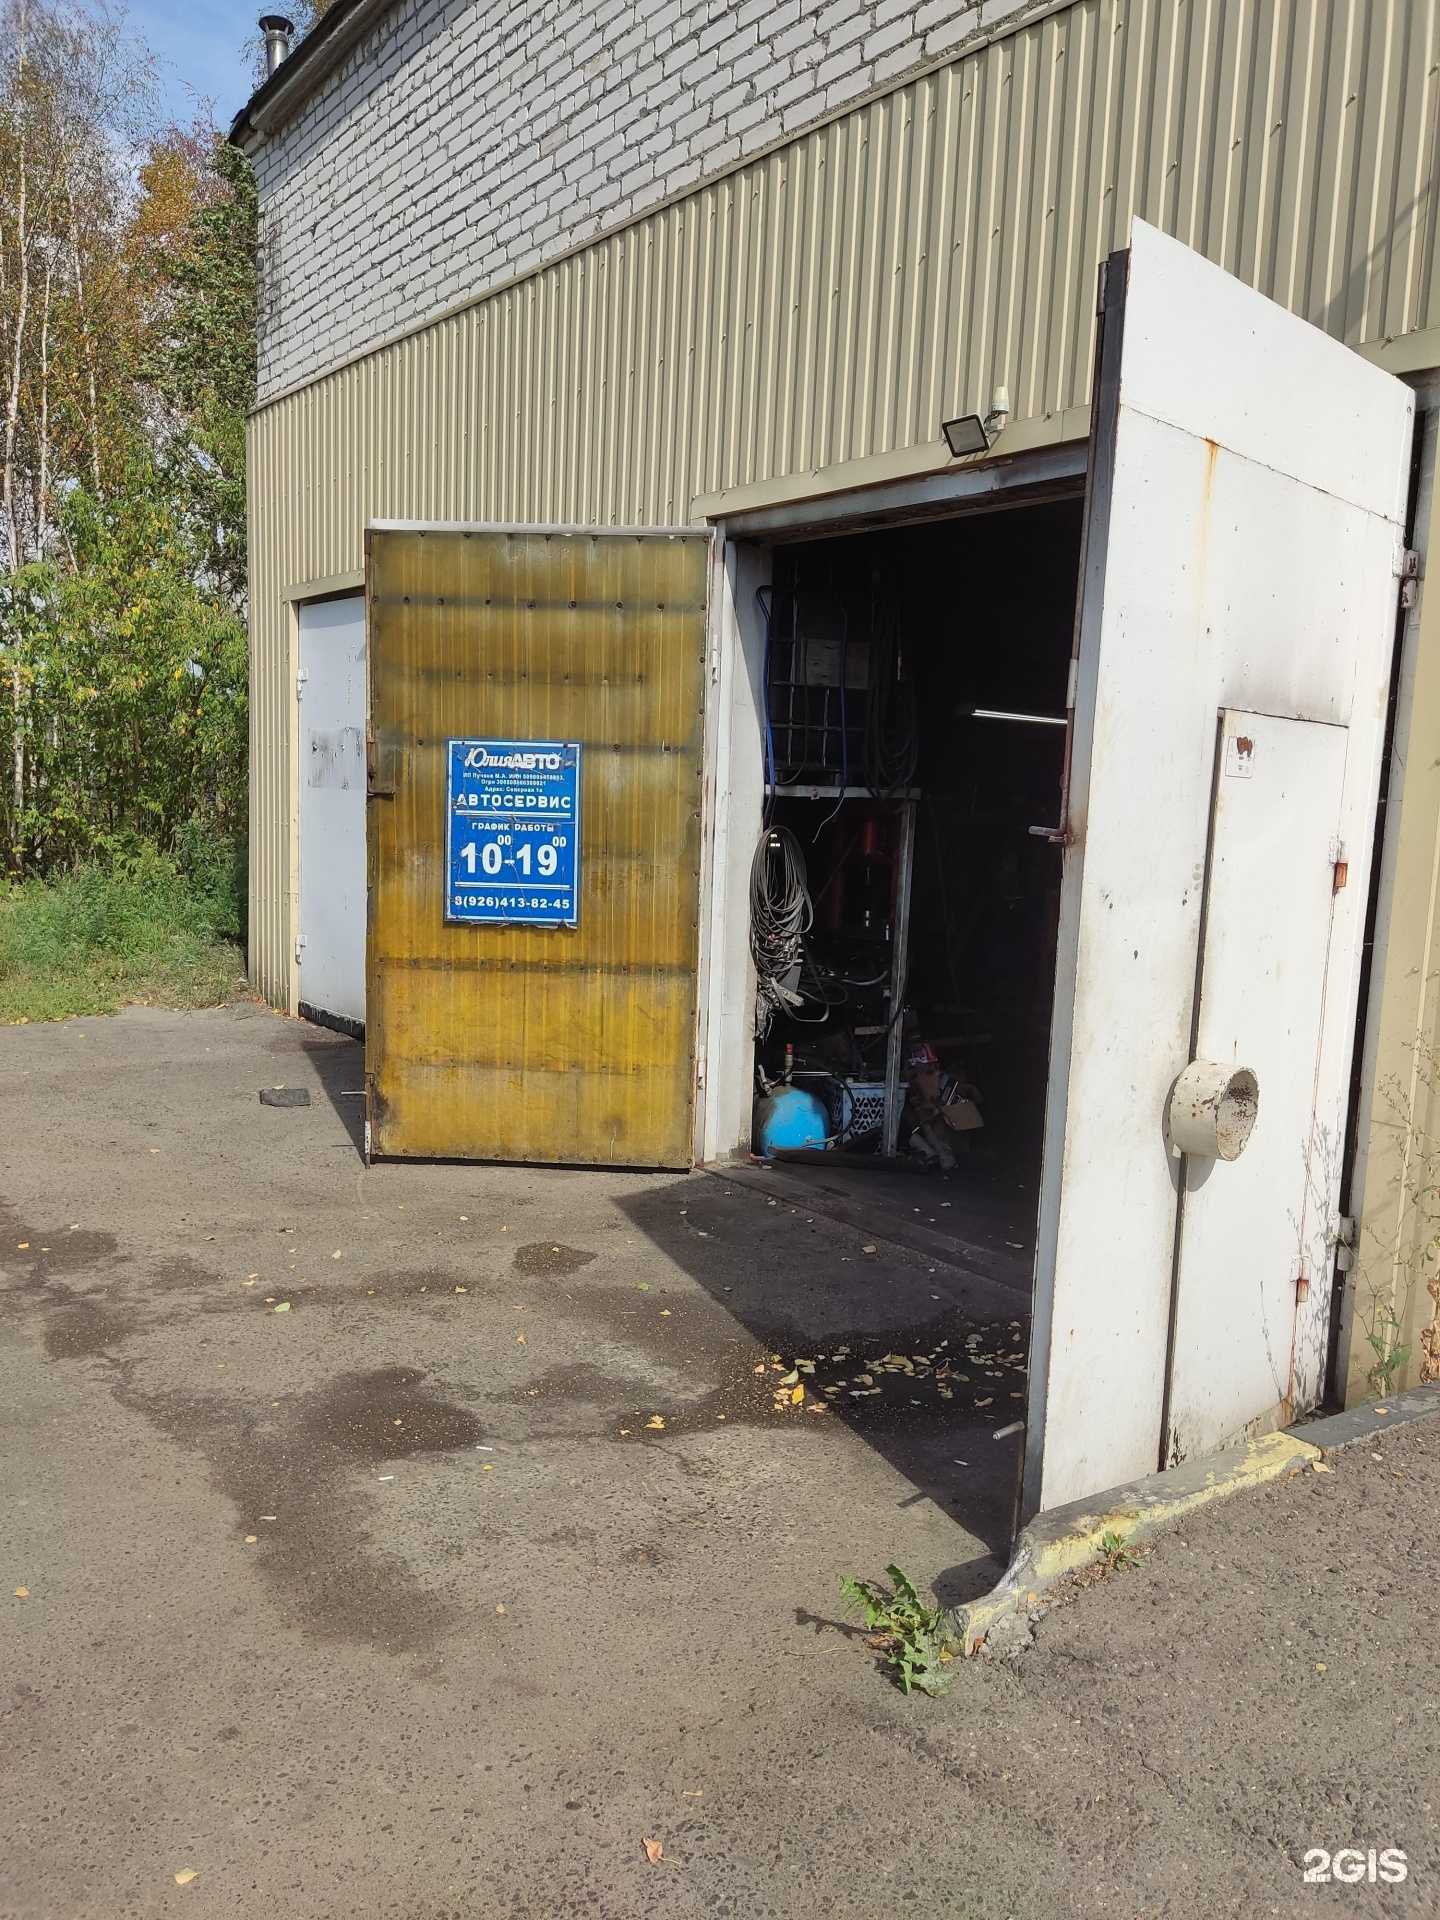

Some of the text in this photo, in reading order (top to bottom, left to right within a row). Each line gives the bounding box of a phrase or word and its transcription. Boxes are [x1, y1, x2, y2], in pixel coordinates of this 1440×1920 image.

[456, 794, 571, 808] АВТОСЕРВИС
[471, 822, 554, 832] ГРАФИК РАБОТЫ
[454, 895, 570, 909] 8(926)413-82-45
